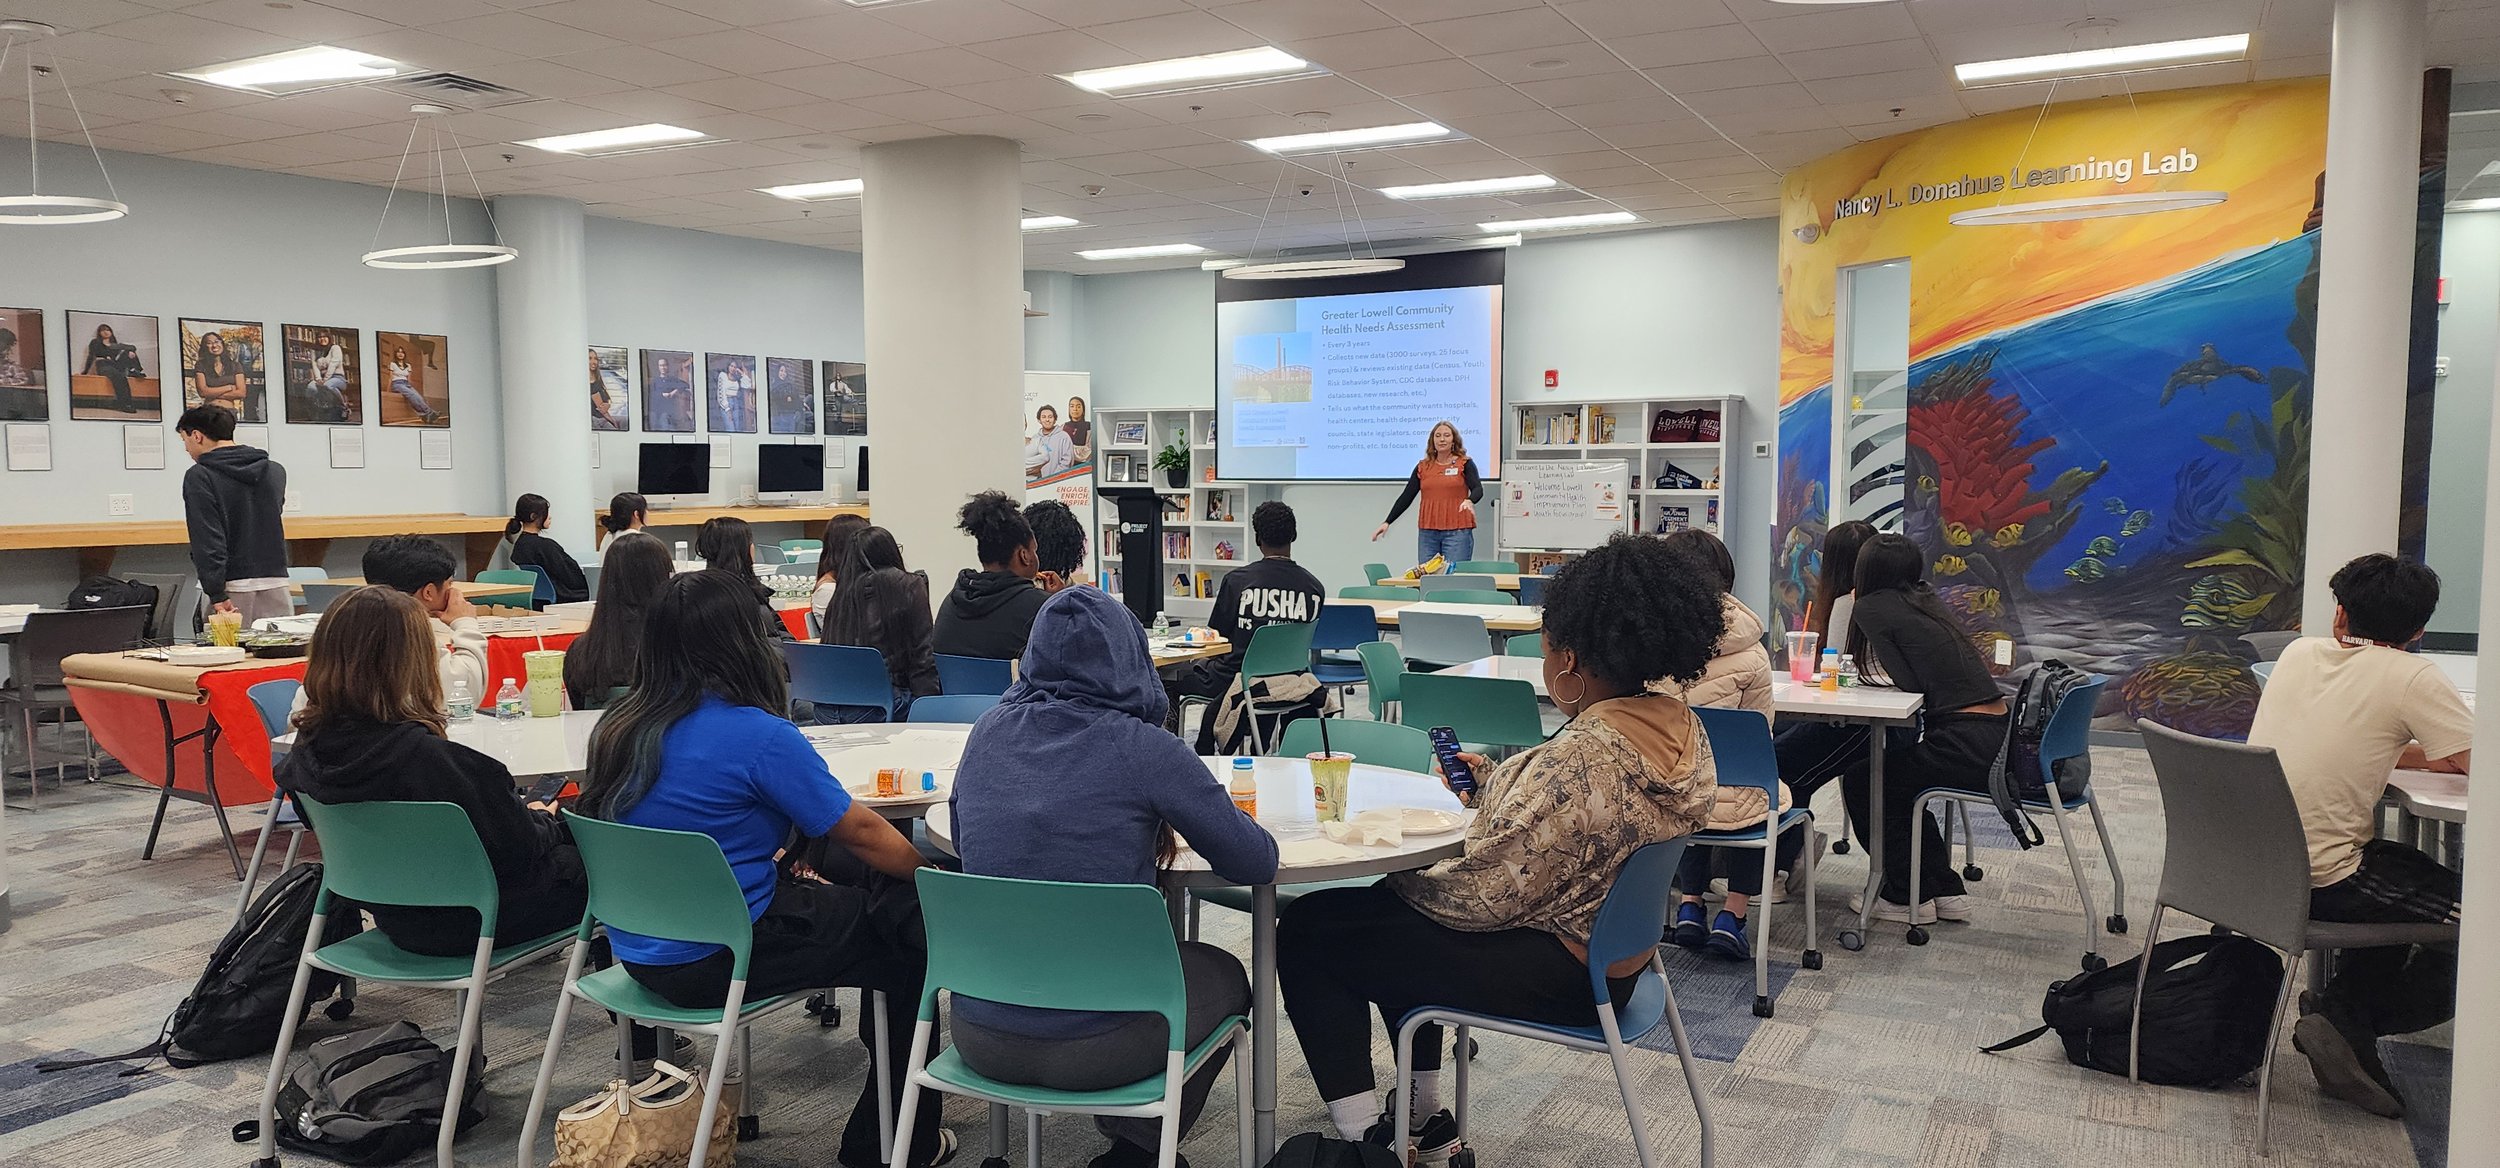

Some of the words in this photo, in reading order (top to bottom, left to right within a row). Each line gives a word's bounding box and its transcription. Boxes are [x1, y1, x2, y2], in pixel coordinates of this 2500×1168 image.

[1835, 191, 1883, 219] Nancy
[1885, 188, 1902, 209] L.
[1909, 174, 2004, 204] Donahue
[2012, 157, 2132, 190] Learning
[2143, 147, 2199, 175] Lab
[1321, 310, 1359, 320] Greater
[1361, 306, 1394, 318] Lowell
[1396, 303, 1454, 316] Community
[1321, 323, 1352, 335] Health
[1355, 322, 1385, 333] Needs
[1387, 320, 1445, 331] Assessment
[1386, 351, 1408, 359] (3000
[1463, 360, 1485, 368] Youth
[1383, 403, 1420, 411] community
[1534, 482, 1560, 492] Welcome
[1562, 482, 1583, 492] Lowell
[1238, 588, 1307, 621] PUSHA
[1238, 617, 1253, 630] IT'S
[2341, 634, 2374, 646] HARVARD
